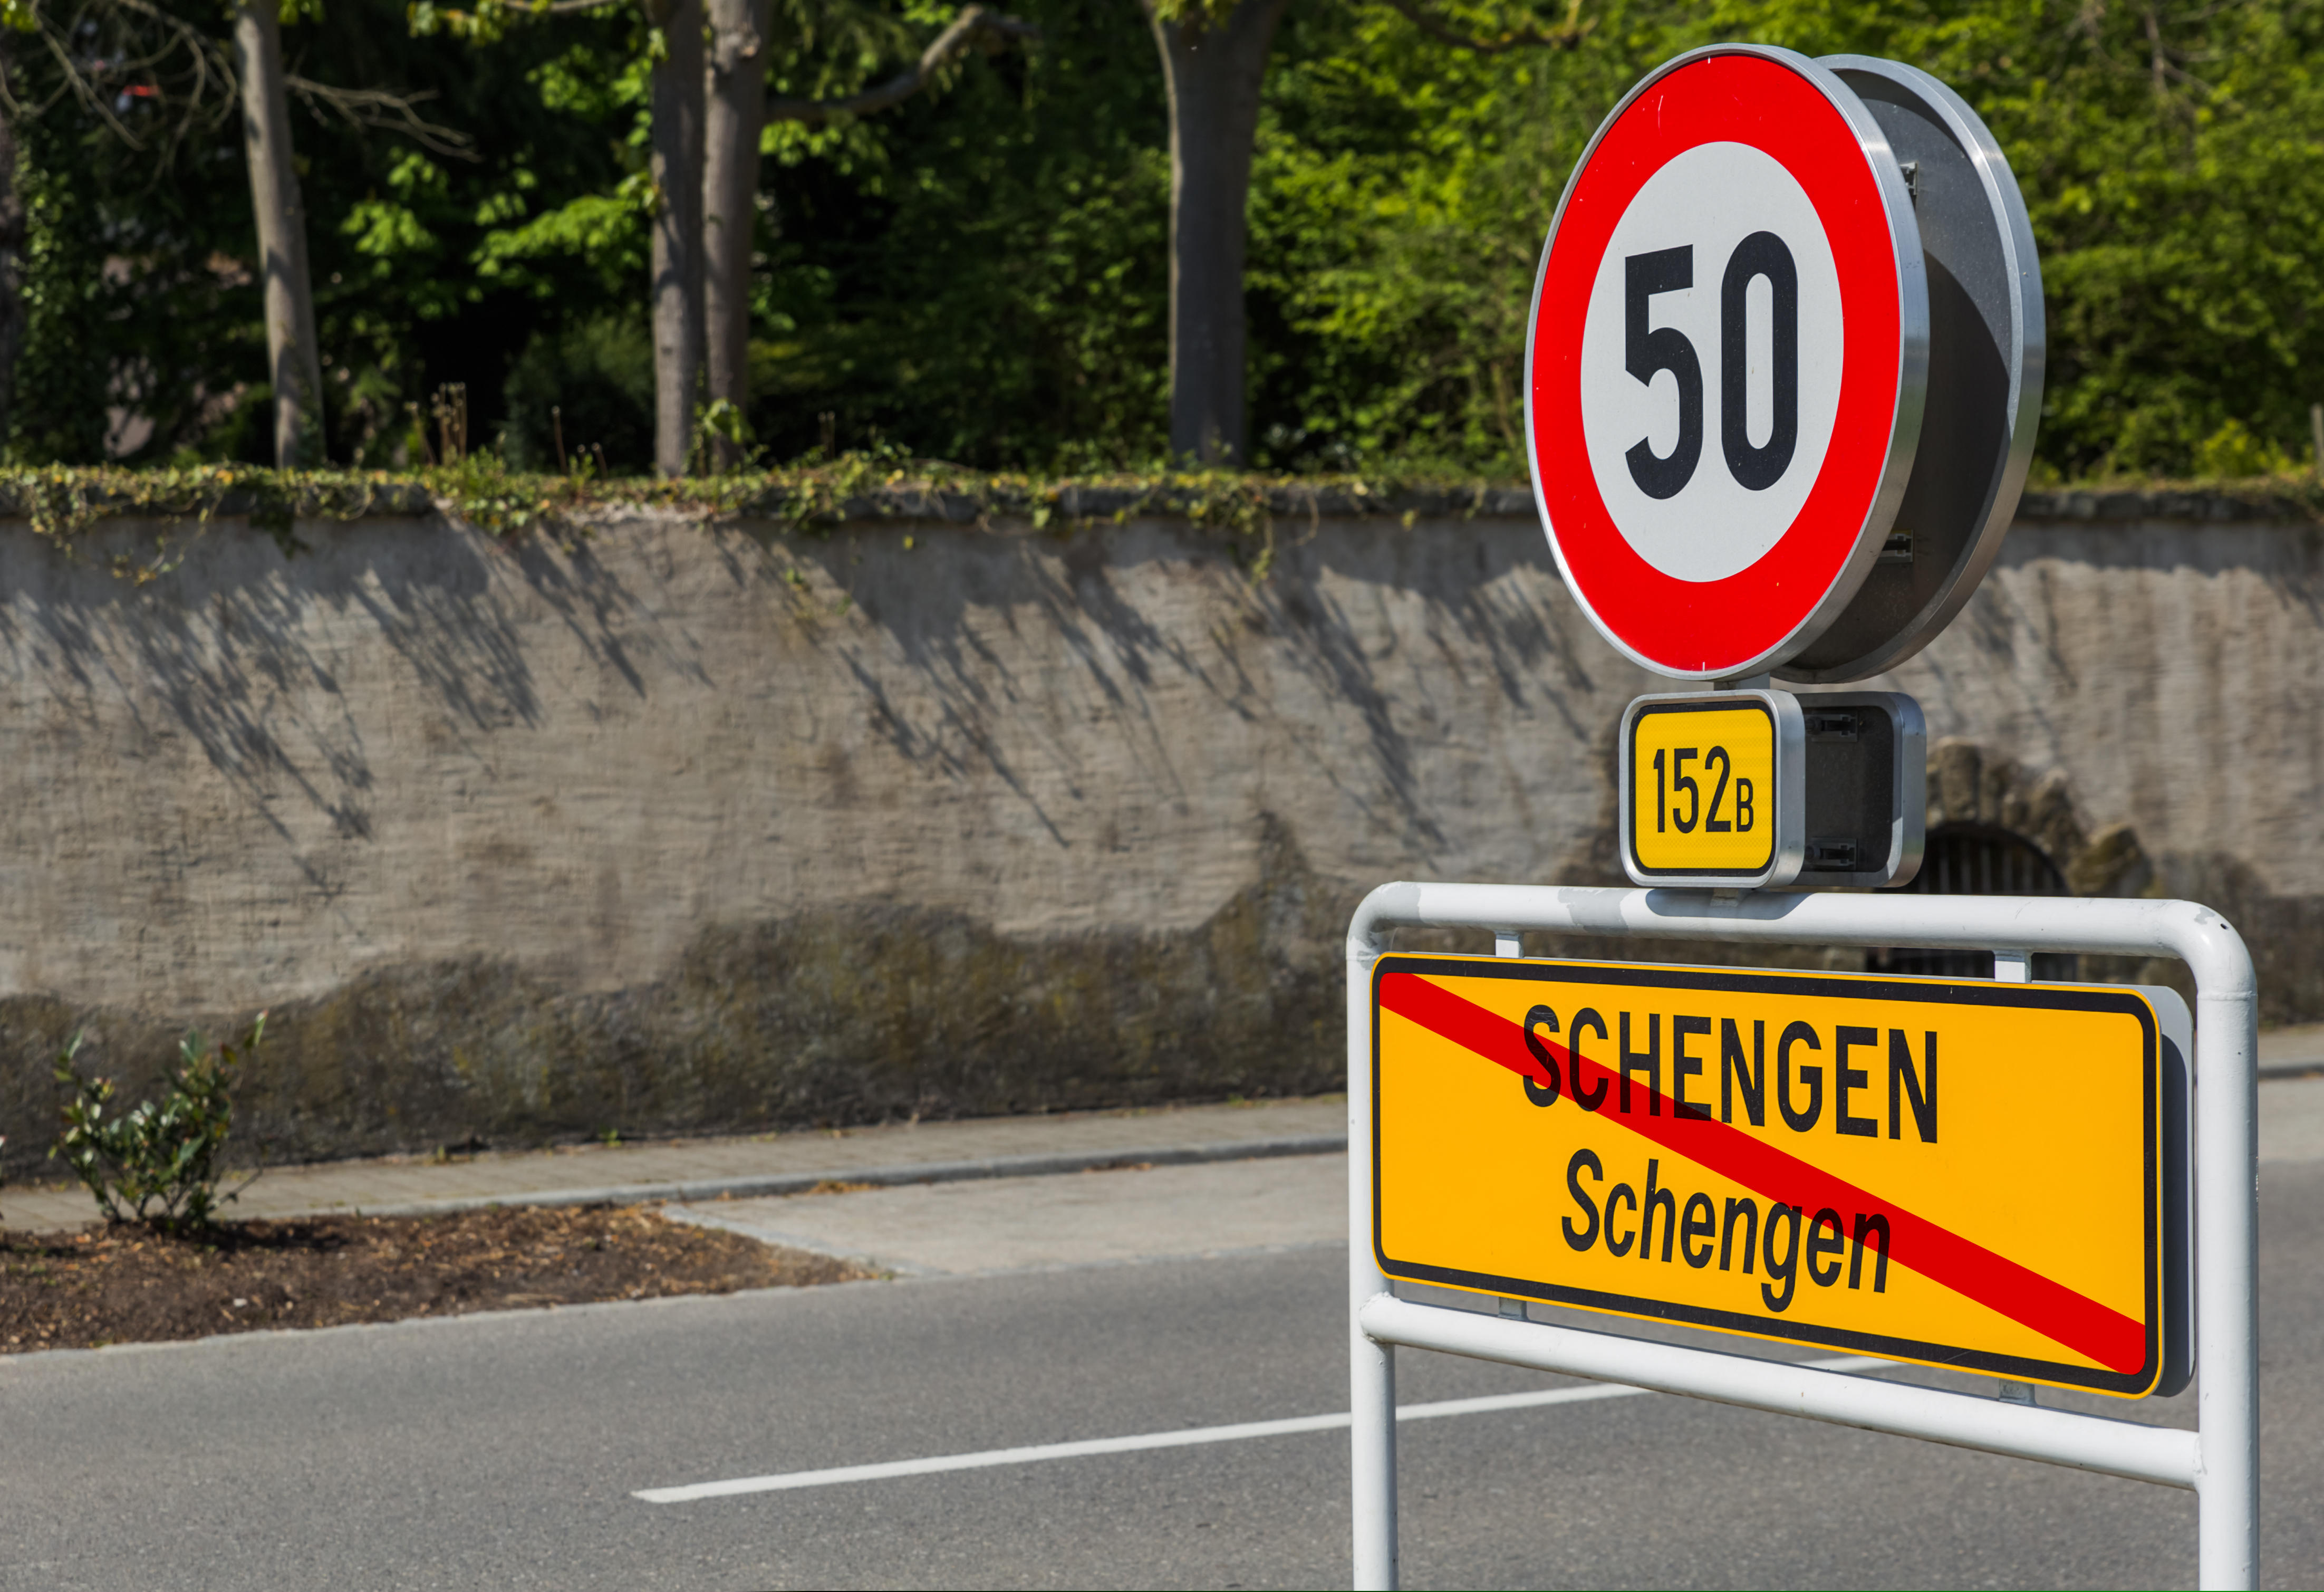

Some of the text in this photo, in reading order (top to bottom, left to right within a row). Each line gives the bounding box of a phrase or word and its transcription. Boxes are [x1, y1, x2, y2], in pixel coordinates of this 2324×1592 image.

[1625, 231, 1798, 500] 50
[1653, 745, 1754, 834] 152B
[1522, 1004, 1937, 1144] SCHENGEN
[1561, 1148, 1891, 1313] Schengen
